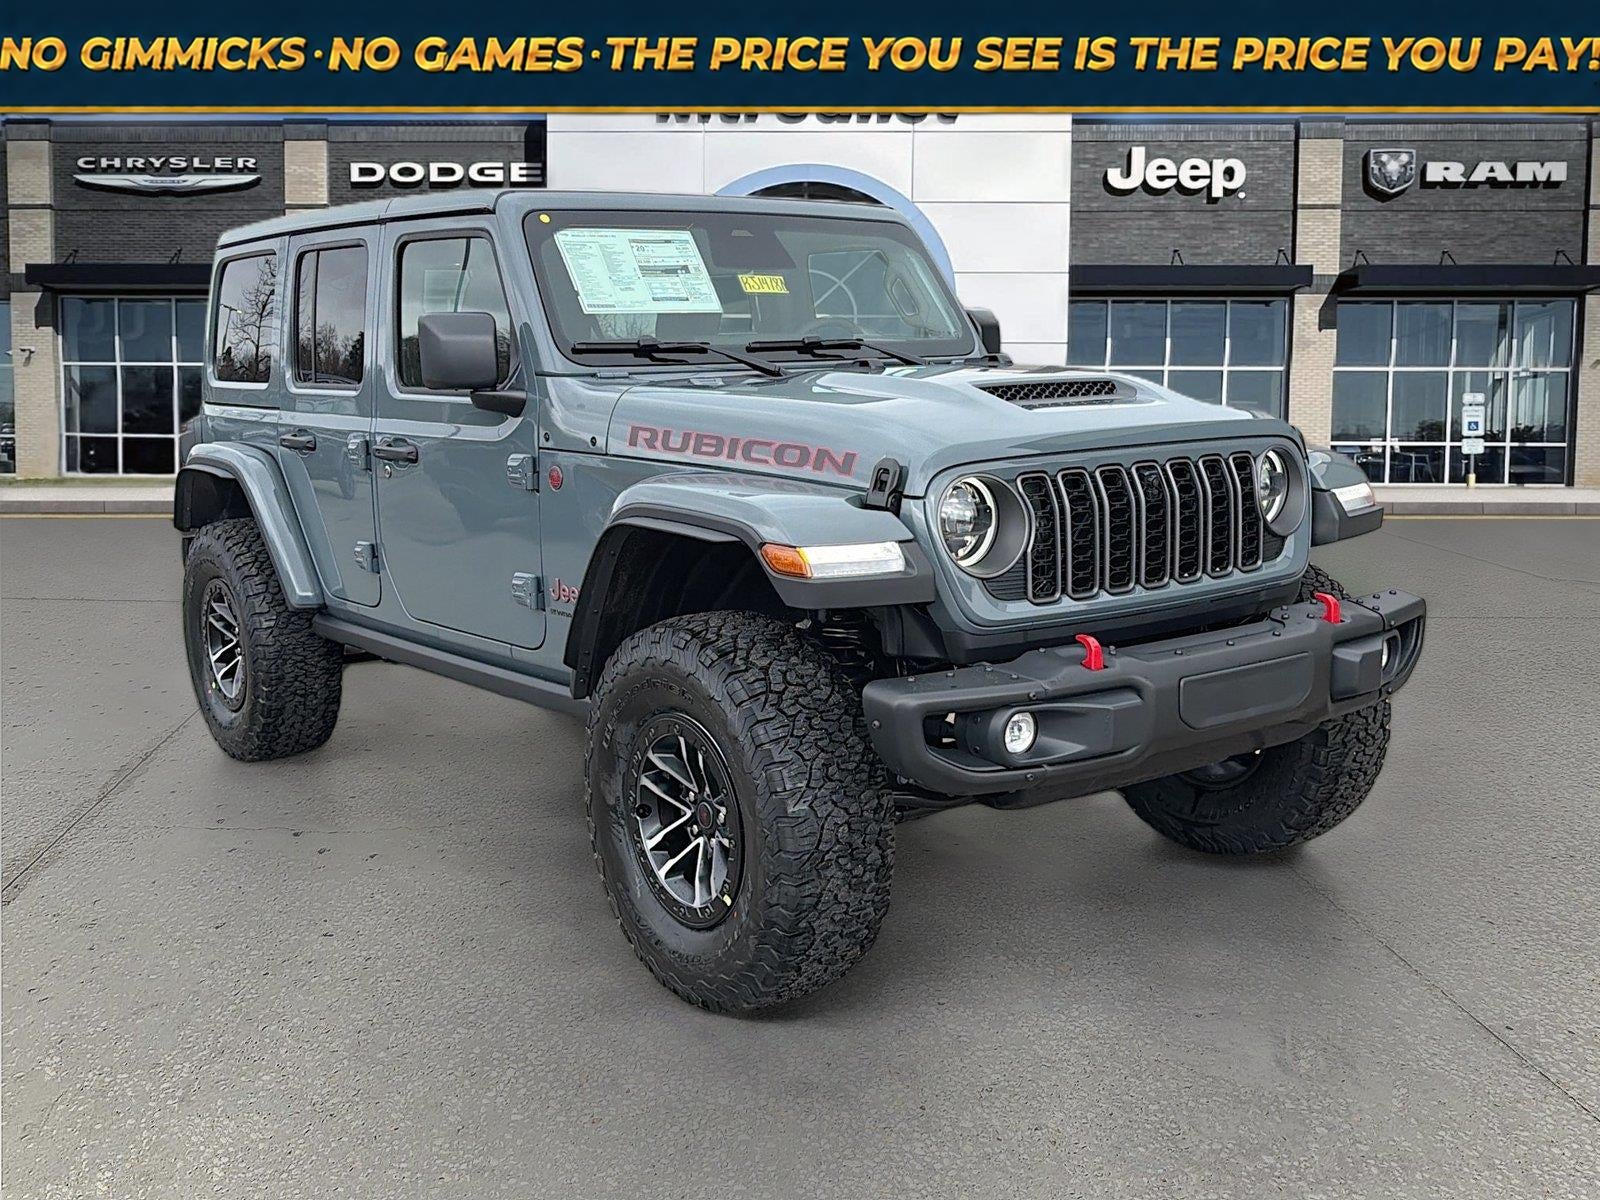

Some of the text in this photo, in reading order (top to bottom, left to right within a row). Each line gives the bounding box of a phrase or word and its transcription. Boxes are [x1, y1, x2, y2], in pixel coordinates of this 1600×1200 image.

[76, 156, 257, 170] CHRYSLER
[350, 162, 543, 183] DODGE
[1106, 146, 1247, 198] Jeep
[1426, 161, 1568, 182] RAM
[628, 425, 858, 476] RUBICON
